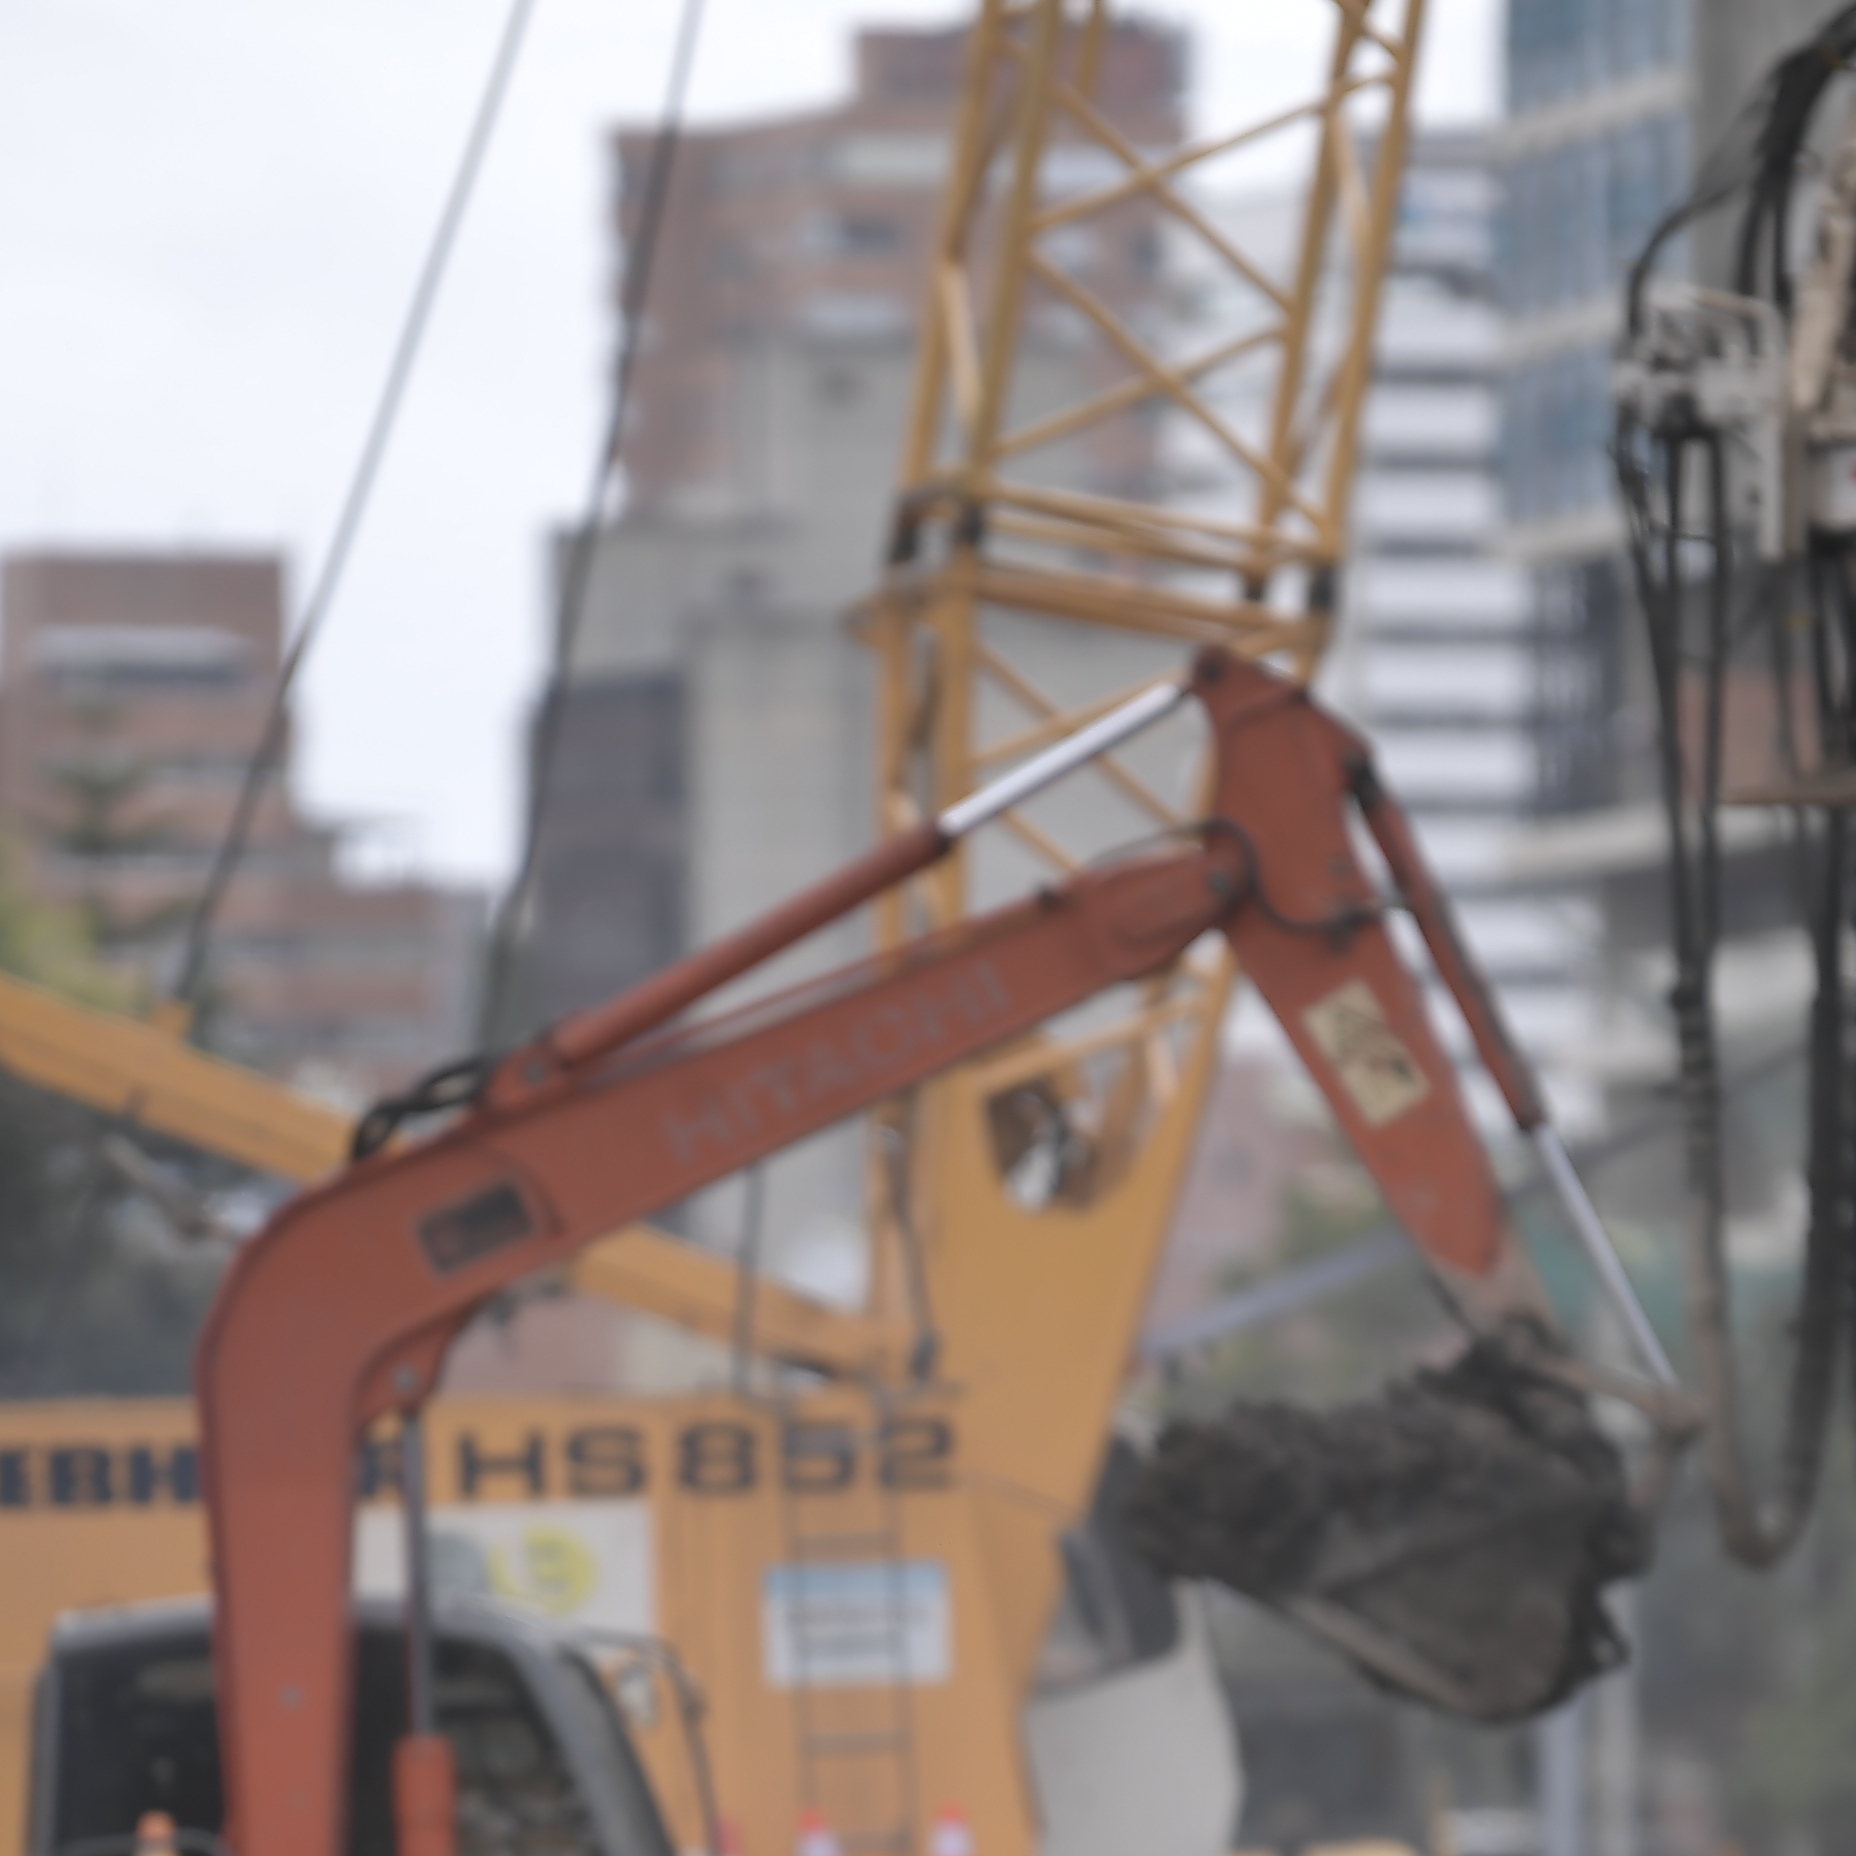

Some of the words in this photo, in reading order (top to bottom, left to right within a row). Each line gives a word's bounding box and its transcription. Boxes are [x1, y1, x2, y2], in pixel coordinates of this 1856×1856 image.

[660, 958, 1013, 1168] HITACHI
[456, 1423, 646, 1500] HS
[677, 1417, 955, 1494] 852
